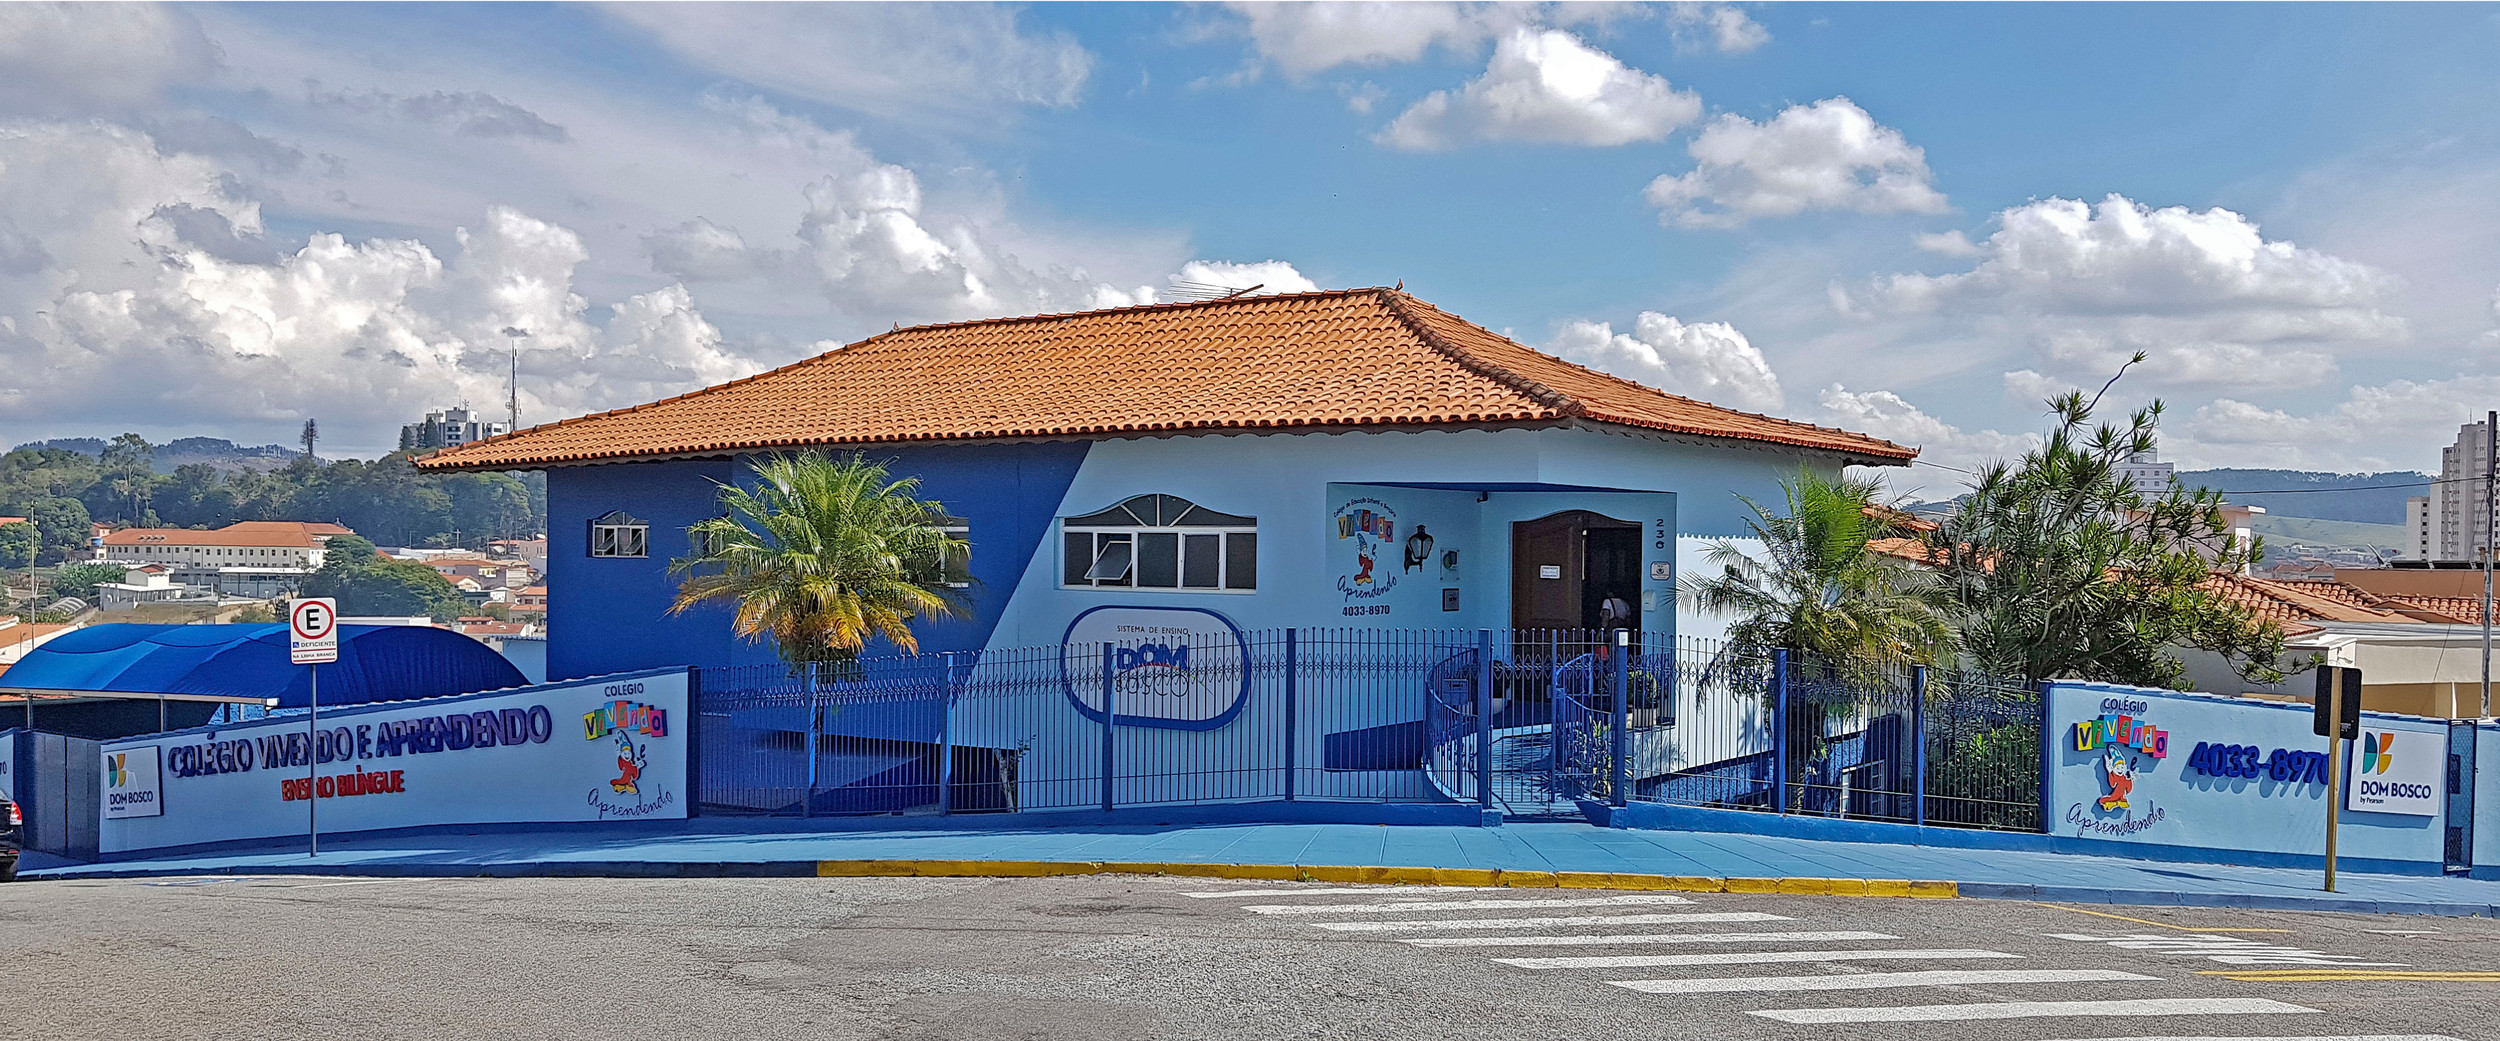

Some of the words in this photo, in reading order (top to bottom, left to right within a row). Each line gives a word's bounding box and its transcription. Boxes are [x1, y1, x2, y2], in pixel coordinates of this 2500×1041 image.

[1337, 571, 1397, 603] Aprendendo
[306, 609, 320, 630] E
[1342, 605, 1390, 617] 4033-8970
[1117, 625, 1146, 634] SISTEMA
[1148, 626, 1159, 634] DE
[1161, 627, 1189, 636] ENSINO
[1117, 643, 1188, 671] DOM
[604, 680, 644, 697] COLÉGIO
[2103, 696, 2148, 713] COLÉGIO
[168, 730, 254, 778] COLÉGIO
[255, 726, 354, 769] VIVENDO
[357, 724, 373, 759] E
[375, 704, 553, 758] APRENDENDO
[336, 764, 405, 796] BILÍNGUE
[2360, 780, 2390, 797] DOM
[2390, 782, 2432, 800] BOSCO
[110, 793, 128, 805] DOM
[128, 790, 154, 804] BOSCO
[587, 783, 674, 820] Aprendendo
[2067, 800, 2166, 837] Aprendendo
